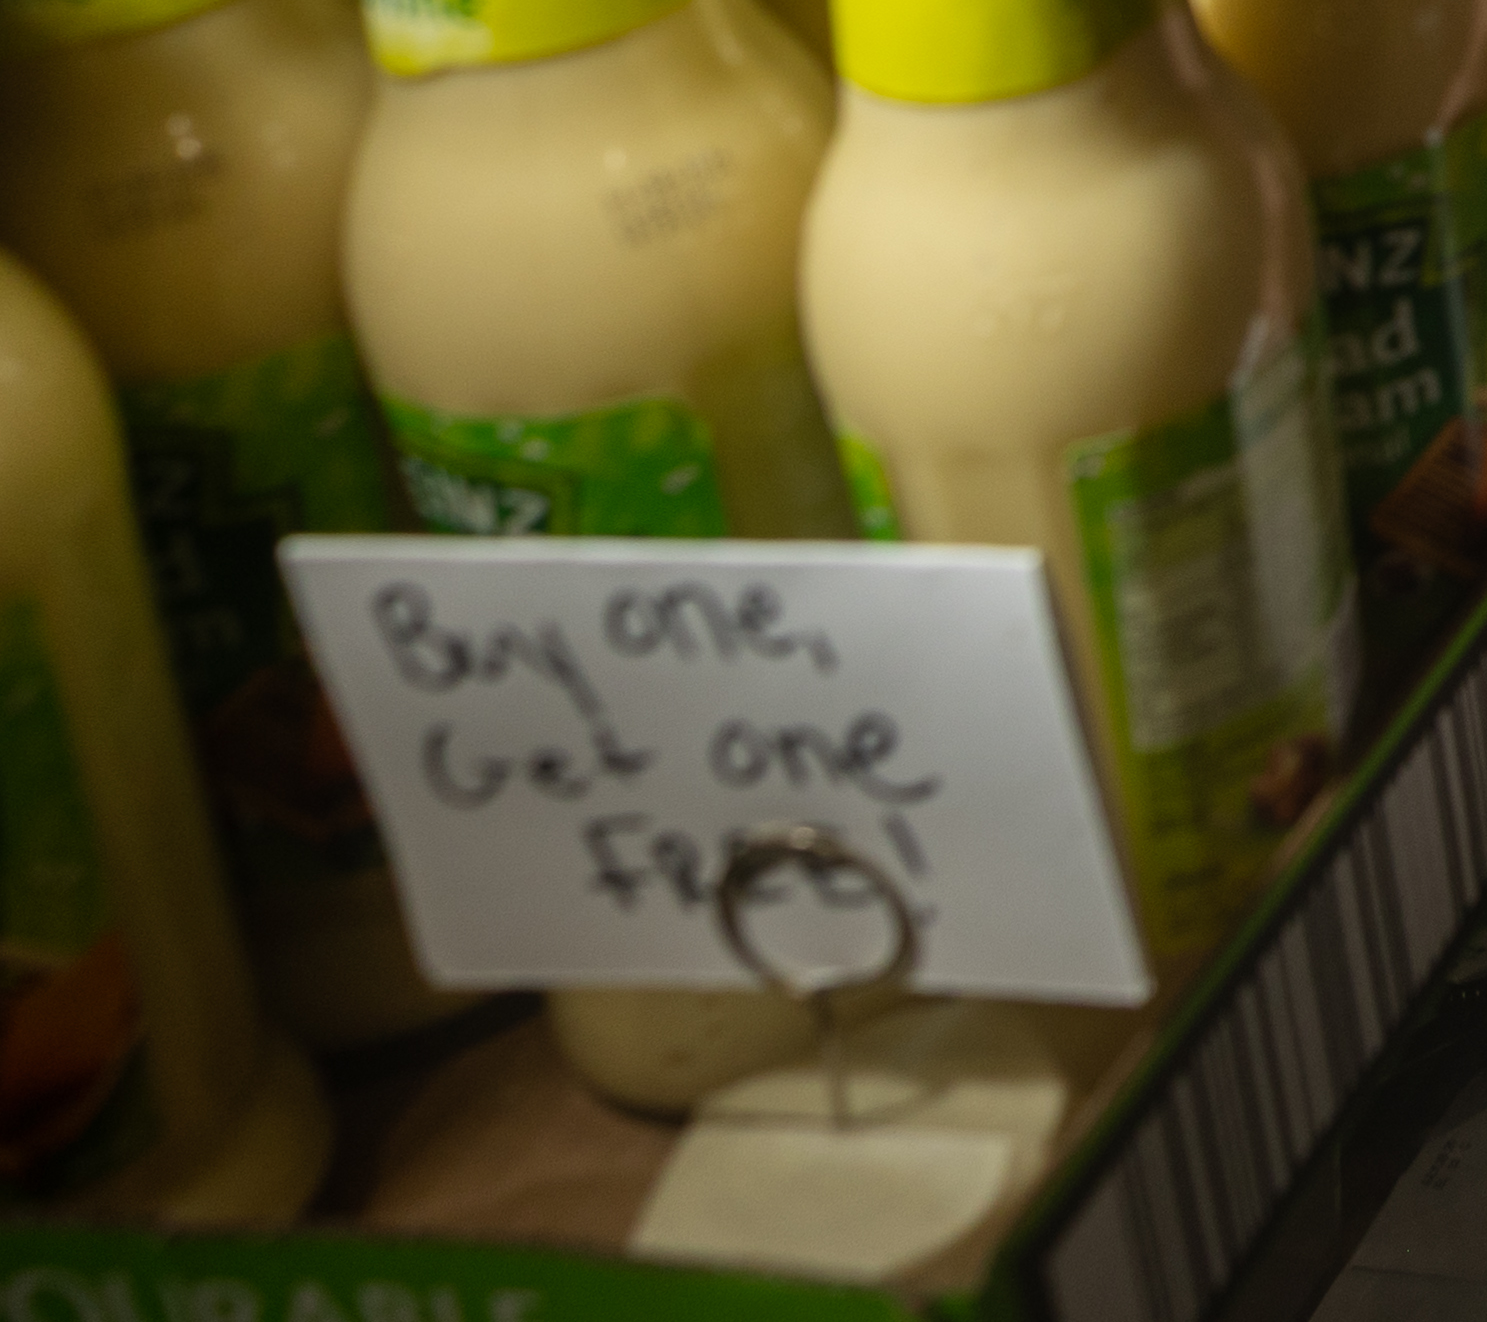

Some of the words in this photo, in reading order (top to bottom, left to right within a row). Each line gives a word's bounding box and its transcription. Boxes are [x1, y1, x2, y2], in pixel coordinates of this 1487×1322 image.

[373, 580, 601, 719] Buy
[710, 710, 938, 805] one
[0, 1262, 548, 1322] OURABLE
